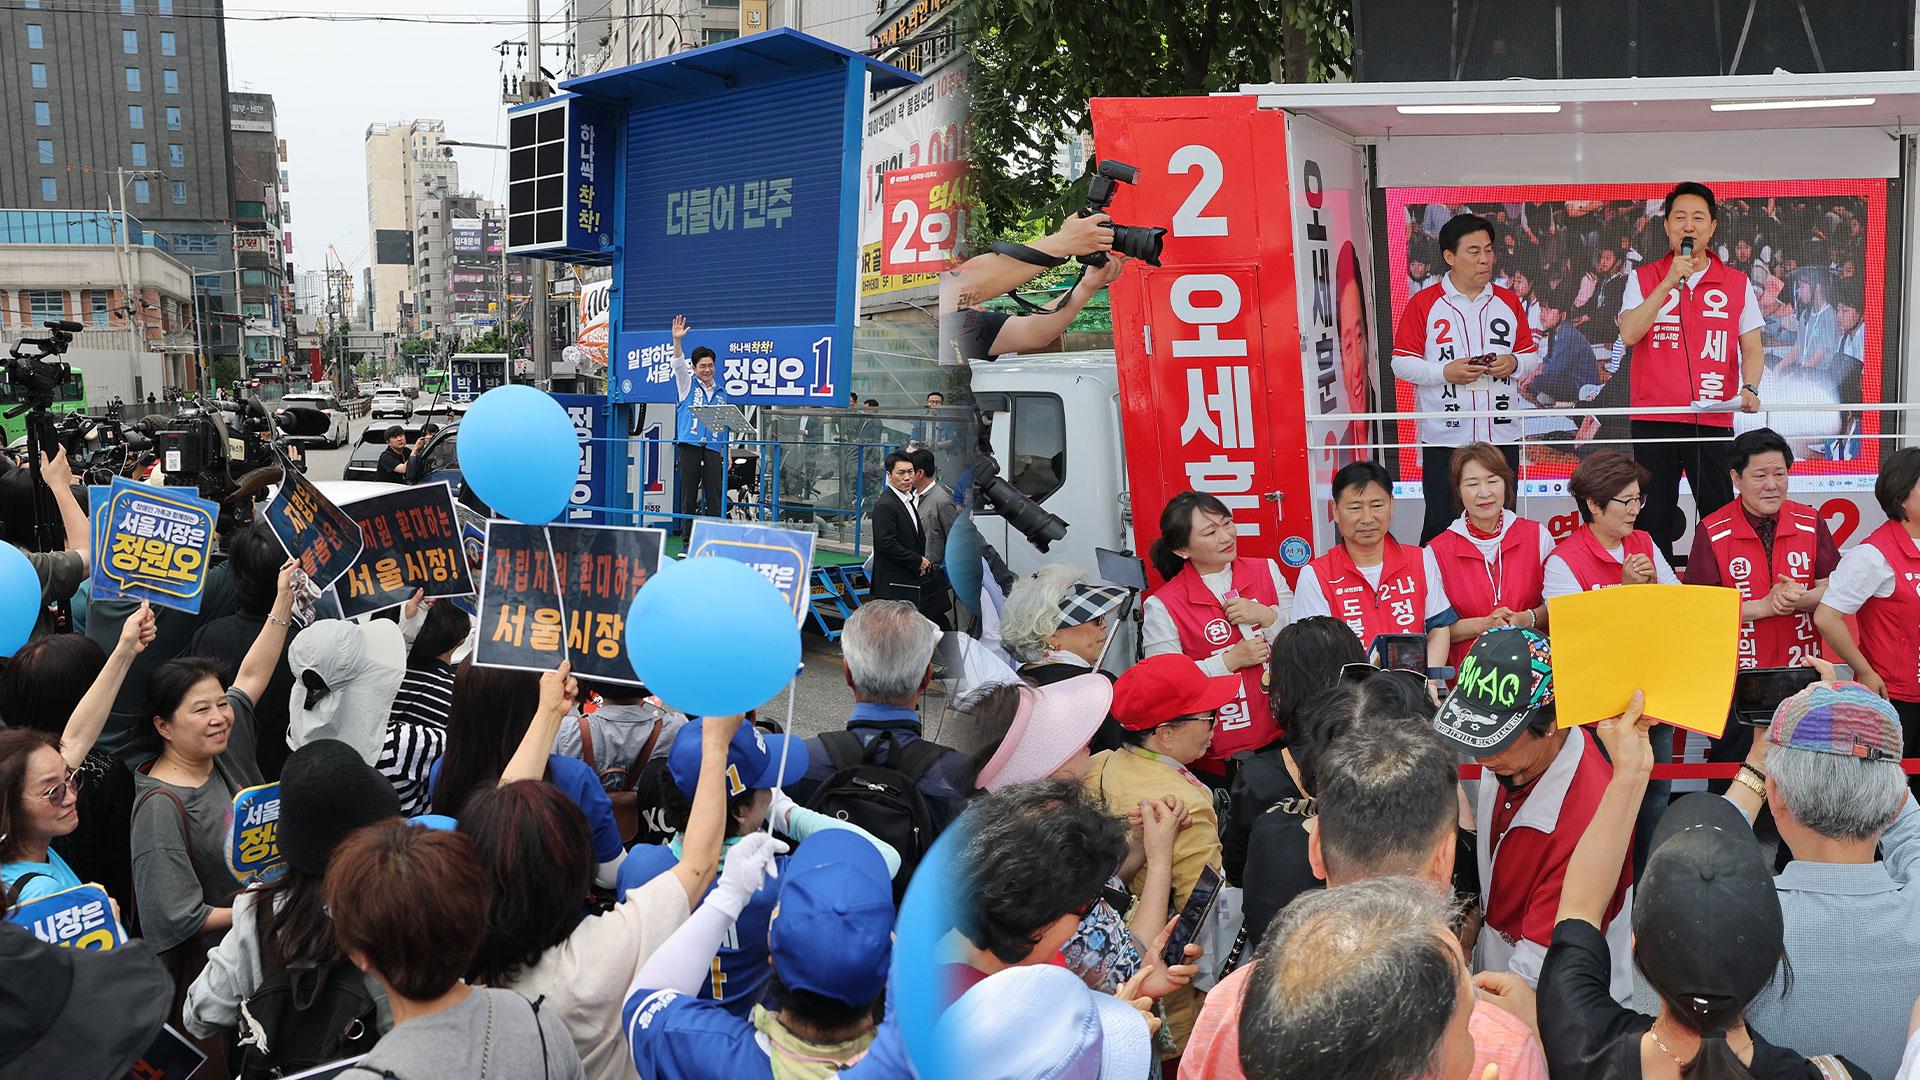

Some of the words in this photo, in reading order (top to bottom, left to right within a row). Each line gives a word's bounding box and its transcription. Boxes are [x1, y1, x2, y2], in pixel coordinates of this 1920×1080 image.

[580, 123, 595, 182] 하나씩
[579, 184, 601, 234] 착착!
[667, 184, 736, 236] 더불어
[743, 177, 793, 230] 민주
[1168, 144, 1229, 237] 2
[1303, 159, 1338, 415] 오세훈
[1654, 288, 1680, 324] 2
[729, 342, 751, 354] 하나씩
[751, 340, 774, 355] 착착!
[1433, 318, 1454, 345] 2
[1699, 288, 1728, 402] 오세훈
[723, 357, 805, 397] 정원오
[809, 336, 834, 397] 1
[1170, 274, 1260, 536] 오세훈
[119, 512, 206, 548] 서울시장은
[396, 504, 452, 542] 확대하는
[111, 532, 202, 583] 정원오
[350, 547, 460, 599] 서울시장!
[493, 548, 569, 595] 자립지원
[491, 604, 624, 659] 서울시장
[1206, 620, 1231, 643] 현
[1458, 655, 1520, 708] SWAG
[725, 763, 747, 797] 1
[239, 822, 279, 865] 정
[28, 900, 105, 944] 시장은
